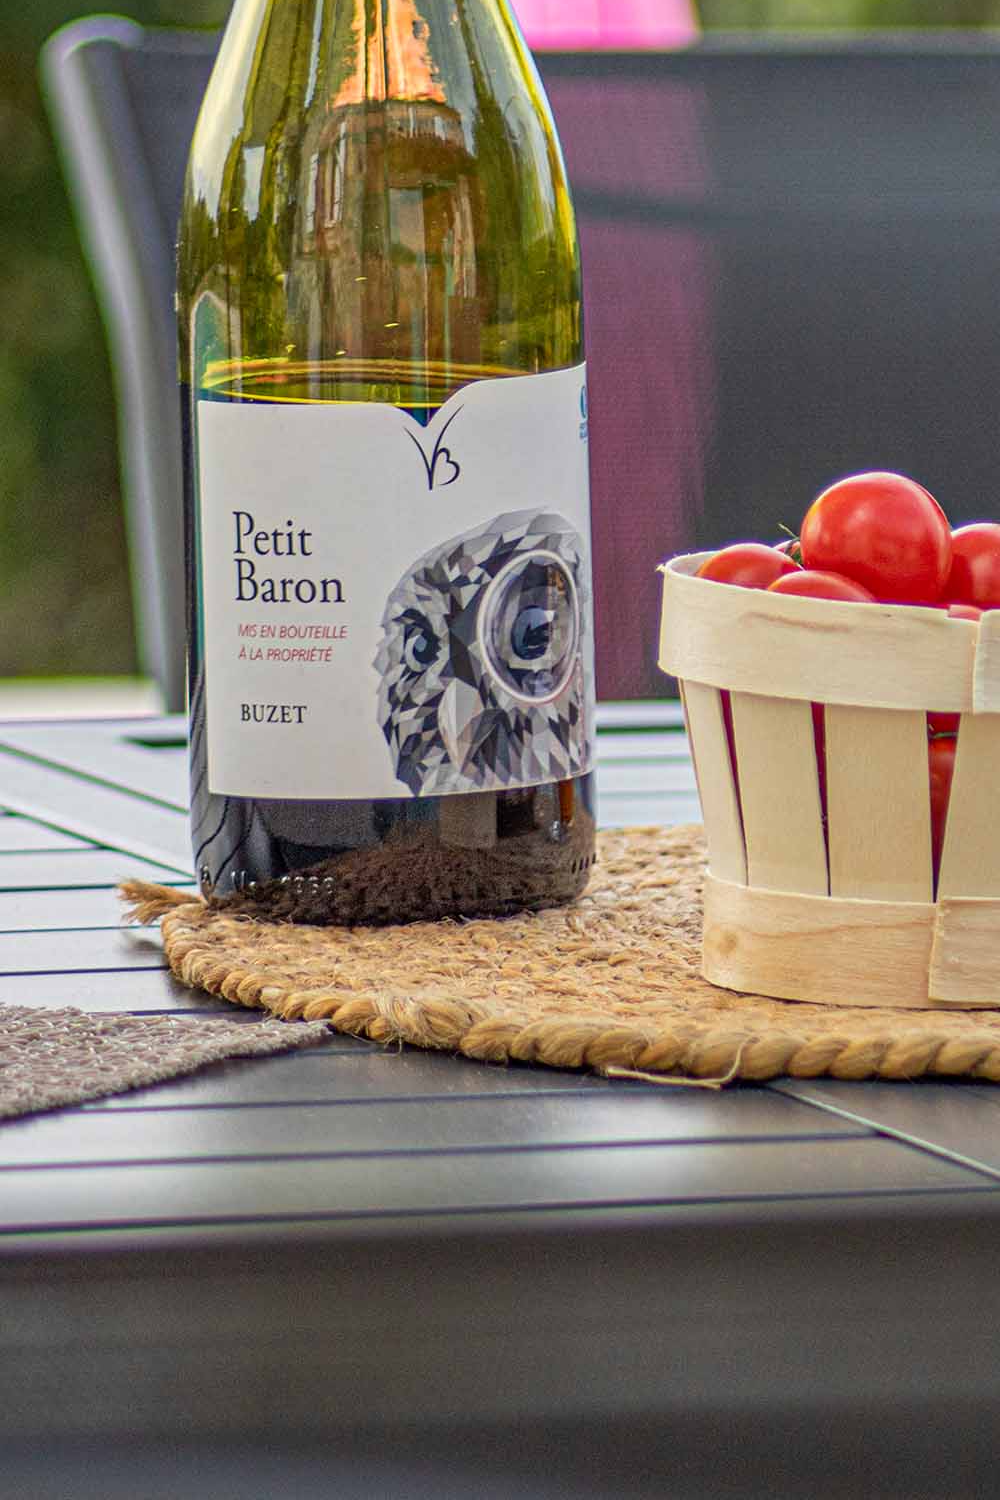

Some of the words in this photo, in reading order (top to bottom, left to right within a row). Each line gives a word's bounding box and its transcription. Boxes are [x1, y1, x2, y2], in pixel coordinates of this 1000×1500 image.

[232, 510, 313, 556] Petit
[234, 558, 347, 604] Baron
[238, 623, 257, 639] MIS
[260, 624, 276, 639] EN
[279, 625, 348, 640] BOUTEILLE
[249, 647, 263, 661] LA
[267, 646, 333, 662] PROPRIÉTÉ
[241, 703, 308, 724] BUZET
